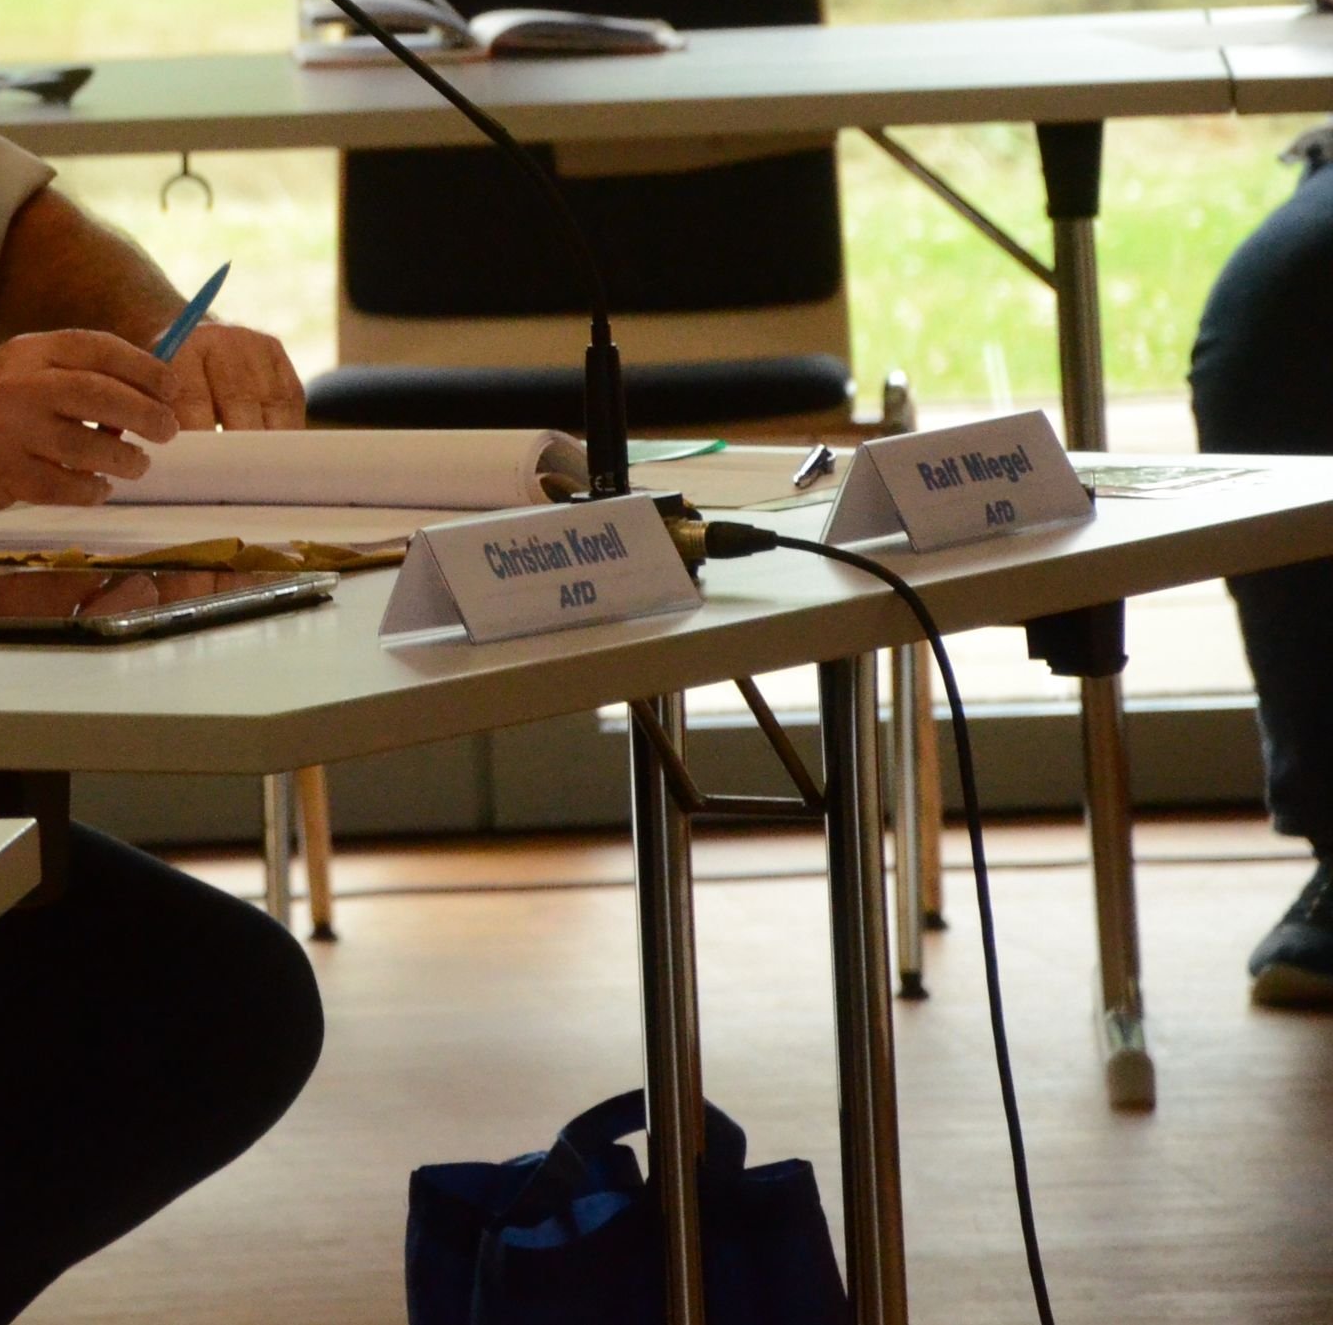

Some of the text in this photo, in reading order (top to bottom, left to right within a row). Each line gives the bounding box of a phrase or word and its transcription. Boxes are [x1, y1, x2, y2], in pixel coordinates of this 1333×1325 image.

[917, 457, 963, 490] Ralf
[985, 500, 1015, 526] AfD
[484, 523, 628, 579] Christian Korell
[560, 580, 597, 608] AfD
